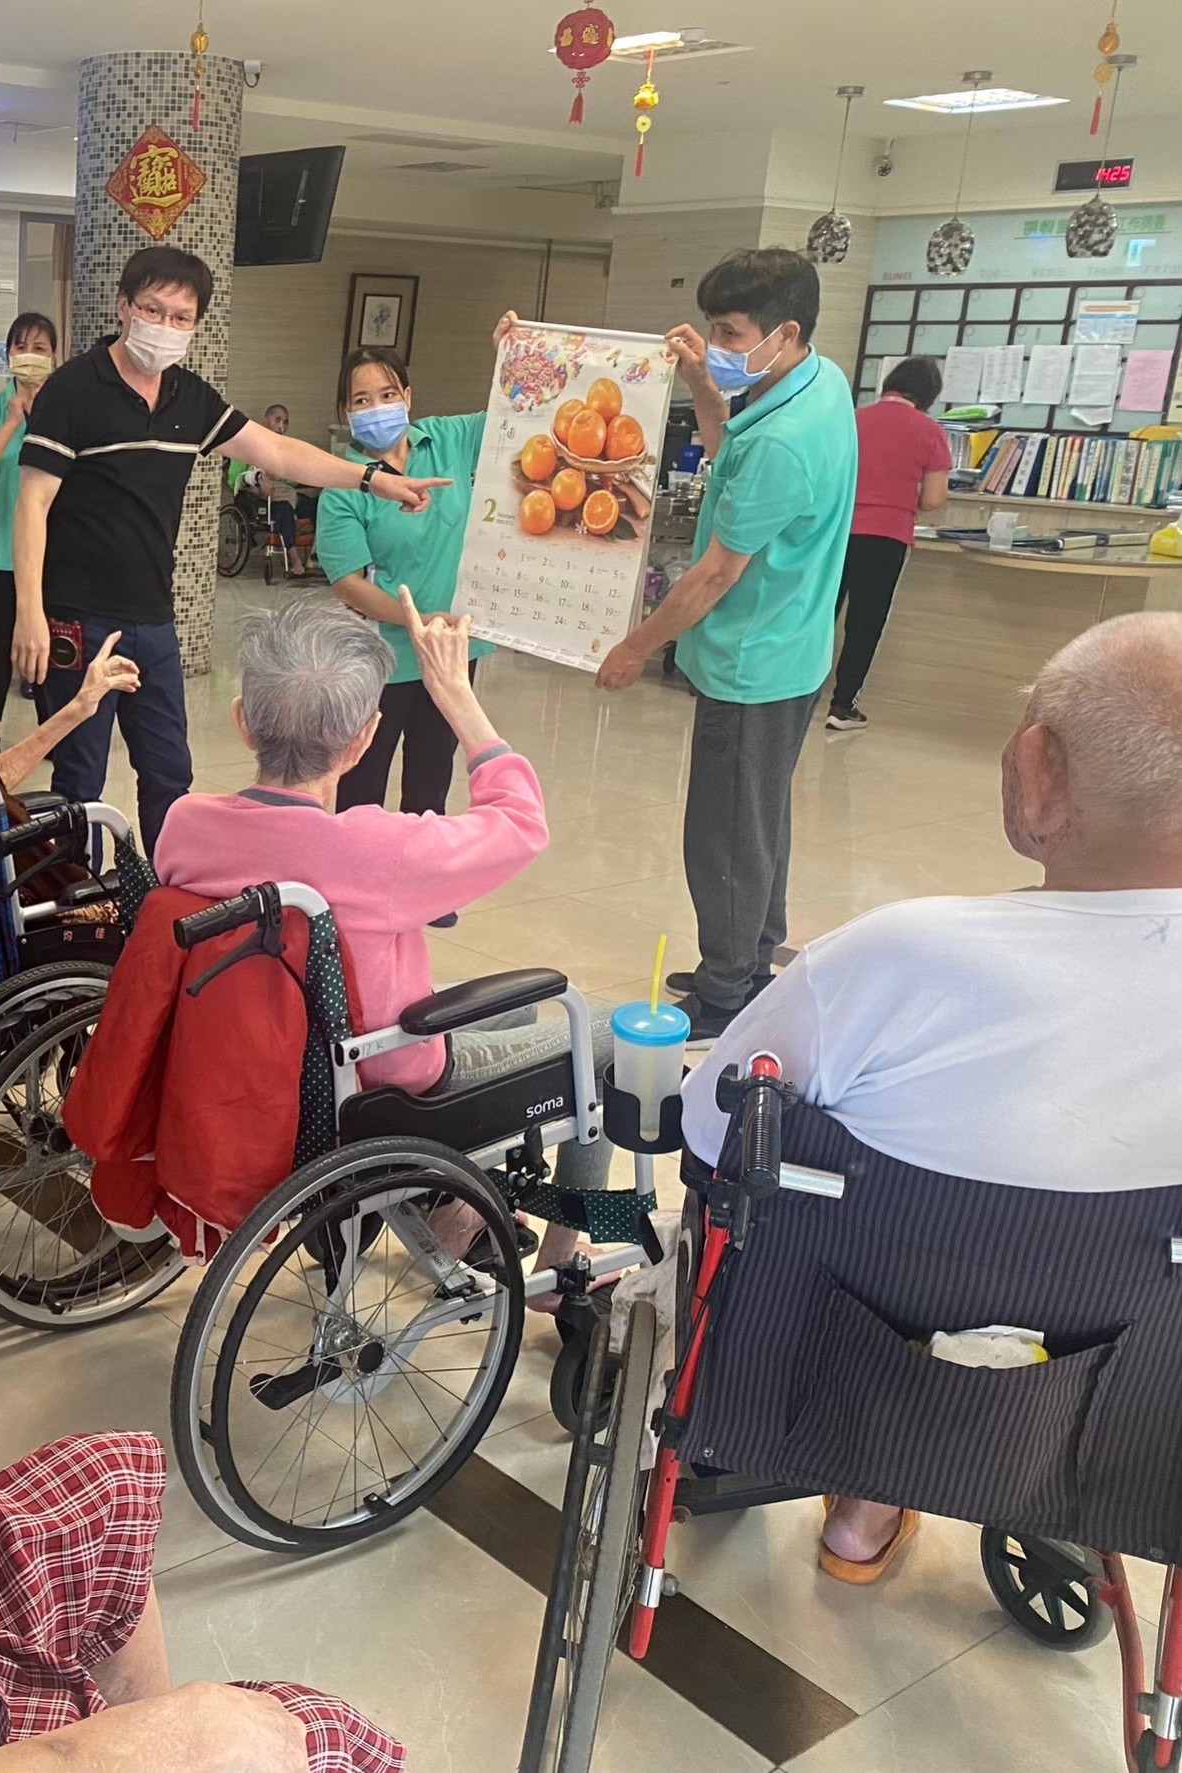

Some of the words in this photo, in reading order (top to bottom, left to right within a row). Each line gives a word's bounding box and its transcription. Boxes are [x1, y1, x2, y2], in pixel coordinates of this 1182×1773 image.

[482, 498, 497, 522] 2
[542, 557, 548, 566] 2
[565, 561, 571, 570] 3
[589, 566, 595, 574] 4
[613, 570, 619, 579] 5
[516, 571, 522, 580] 8
[539, 576, 544, 584] 9
[560, 580, 569, 589] 10
[584, 584, 592, 593] 11
[608, 589, 617, 598] 12
[471, 581, 478, 589] 13
[492, 584, 500, 593] 14
[514, 589, 522, 598] 15
[536, 593, 544, 602] 16
[558, 598, 566, 607] 17
[581, 602, 589, 611] 18
[605, 607, 613, 616] 19
[467, 597, 476, 606] 20
[490, 602, 497, 611] 21
[510, 606, 519, 616] 22
[532, 611, 541, 620] 23
[554, 616, 563, 625] 24
[578, 620, 586, 630] 25
[600, 626, 610, 635] 26
[487, 619, 496, 629] 28
[526, 1096, 564, 1118] soma
